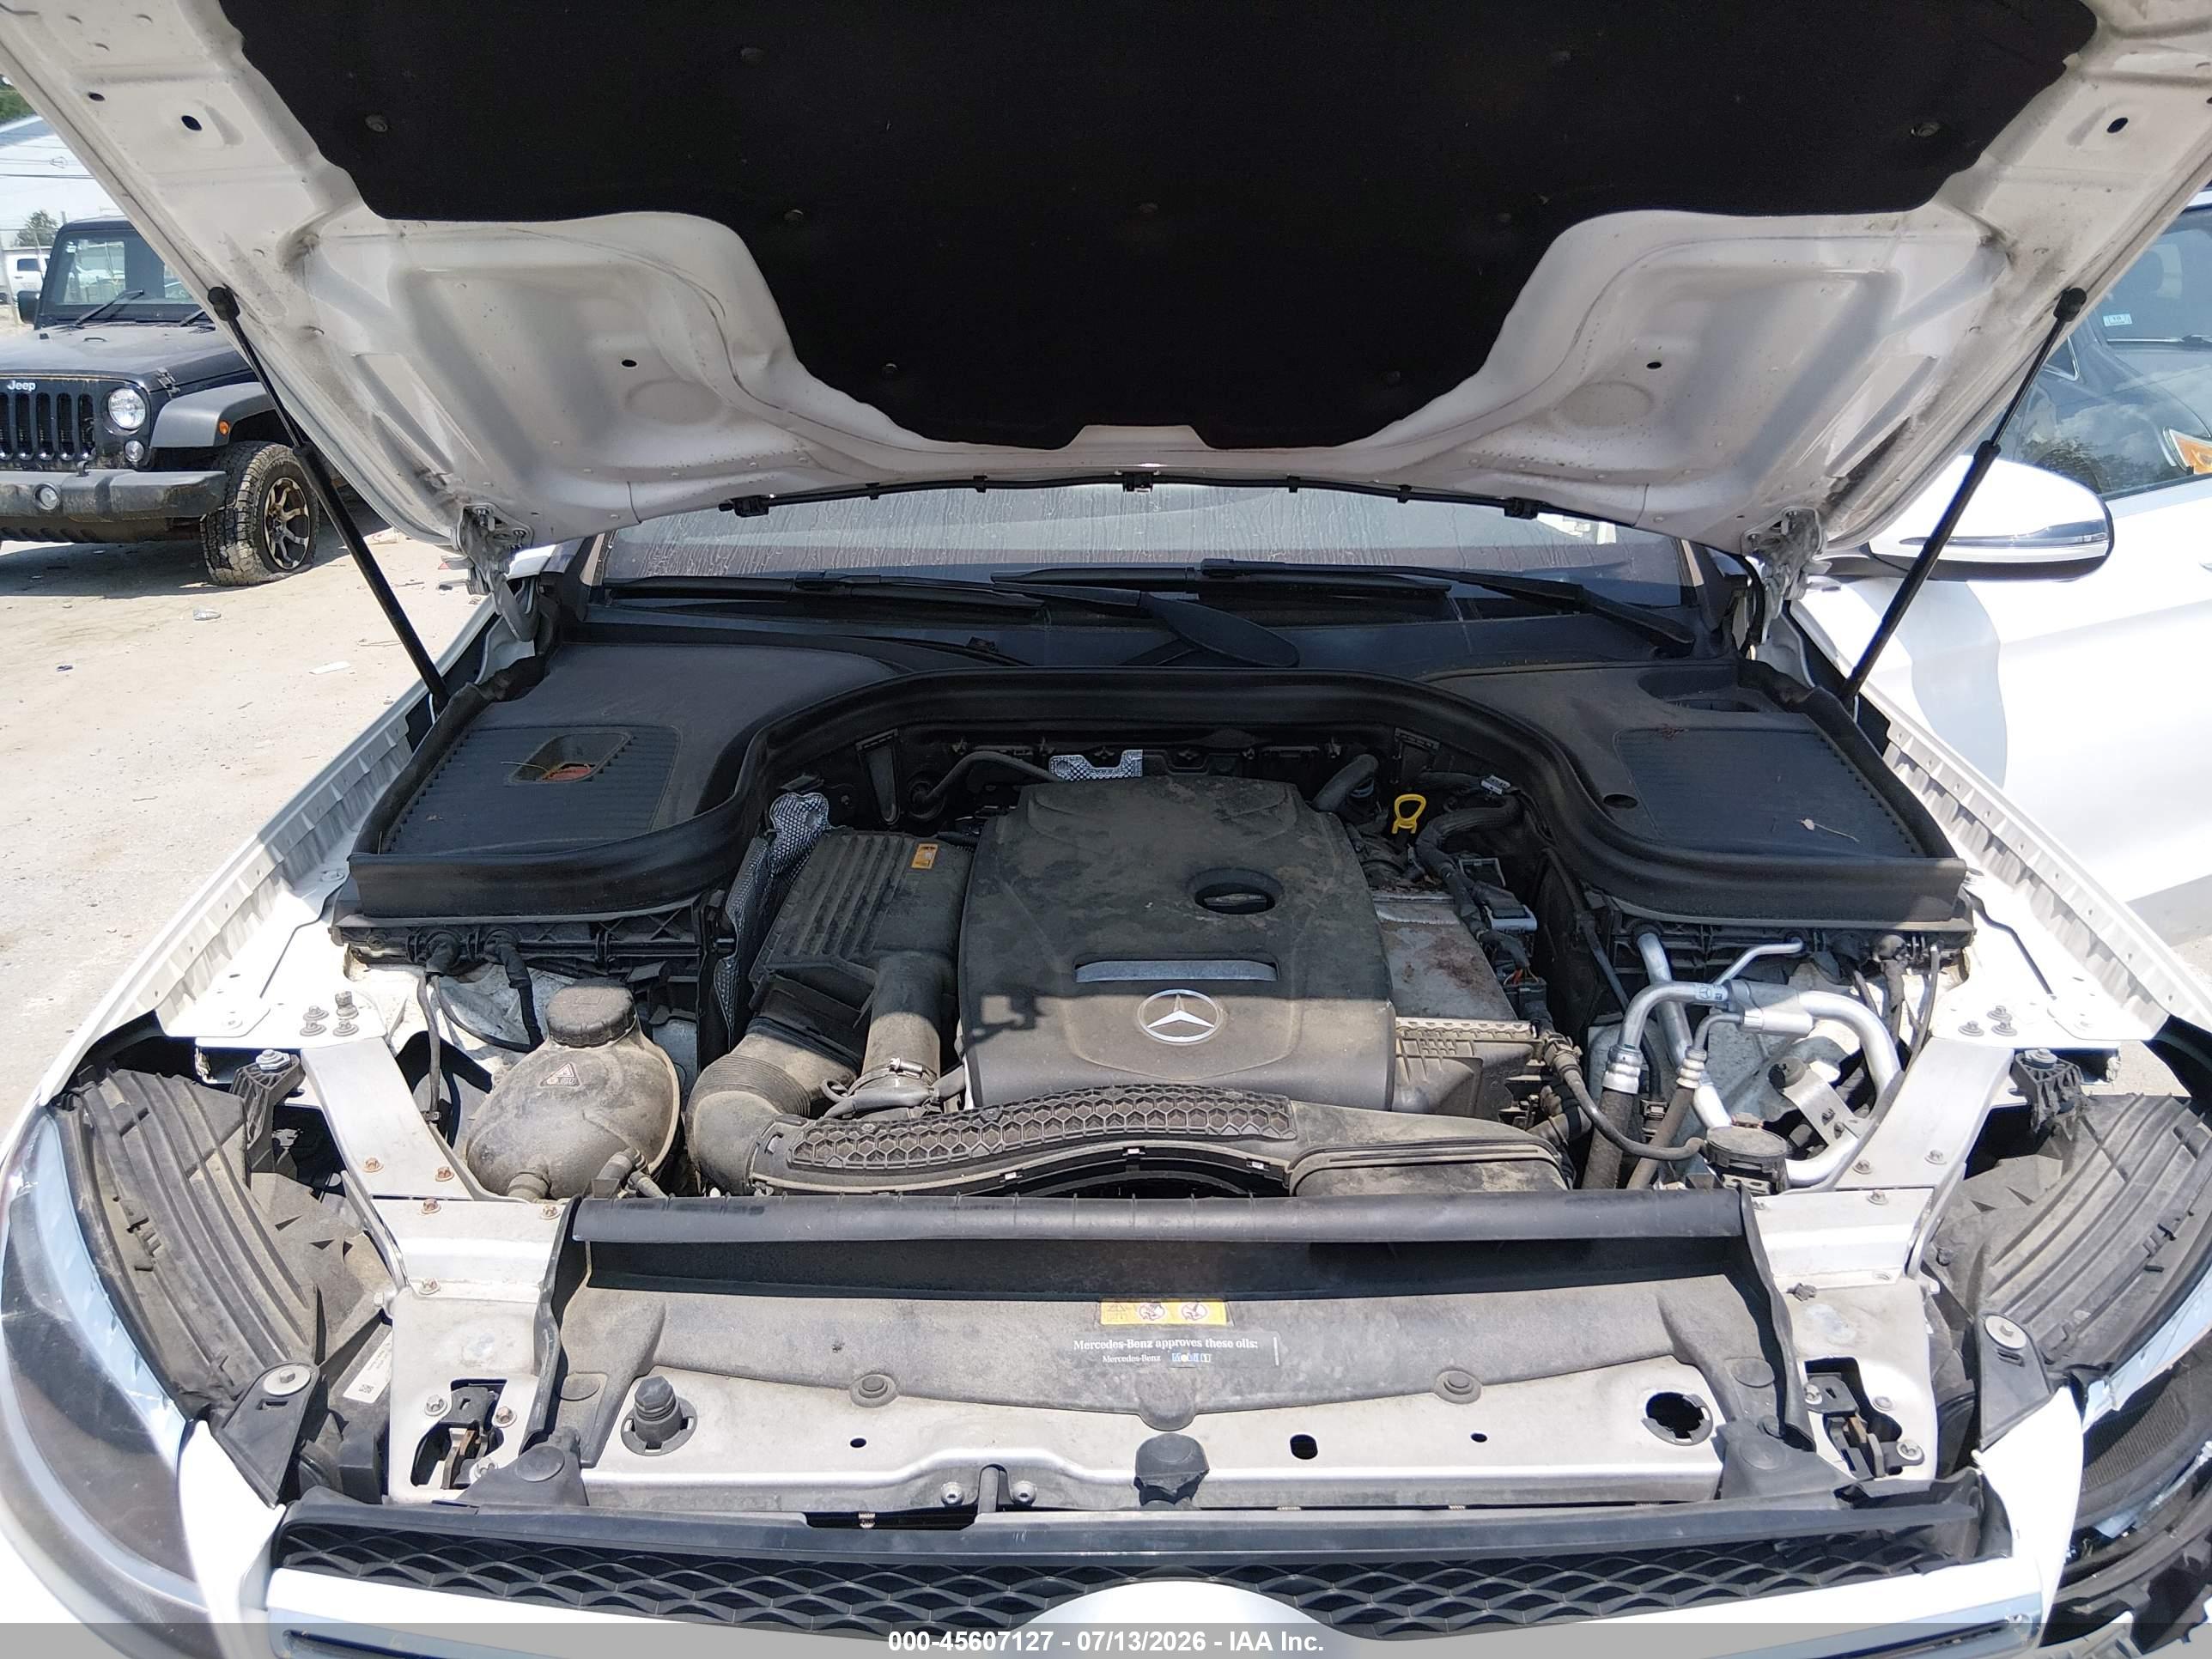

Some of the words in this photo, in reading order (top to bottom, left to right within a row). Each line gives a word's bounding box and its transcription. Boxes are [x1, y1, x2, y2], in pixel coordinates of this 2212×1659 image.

[7, 380, 36, 392] Jeep
[1073, 1340, 1153, 1350] Mercedes-Benz
[1155, 1340, 1202, 1350] approves
[1205, 1339, 1234, 1348] these
